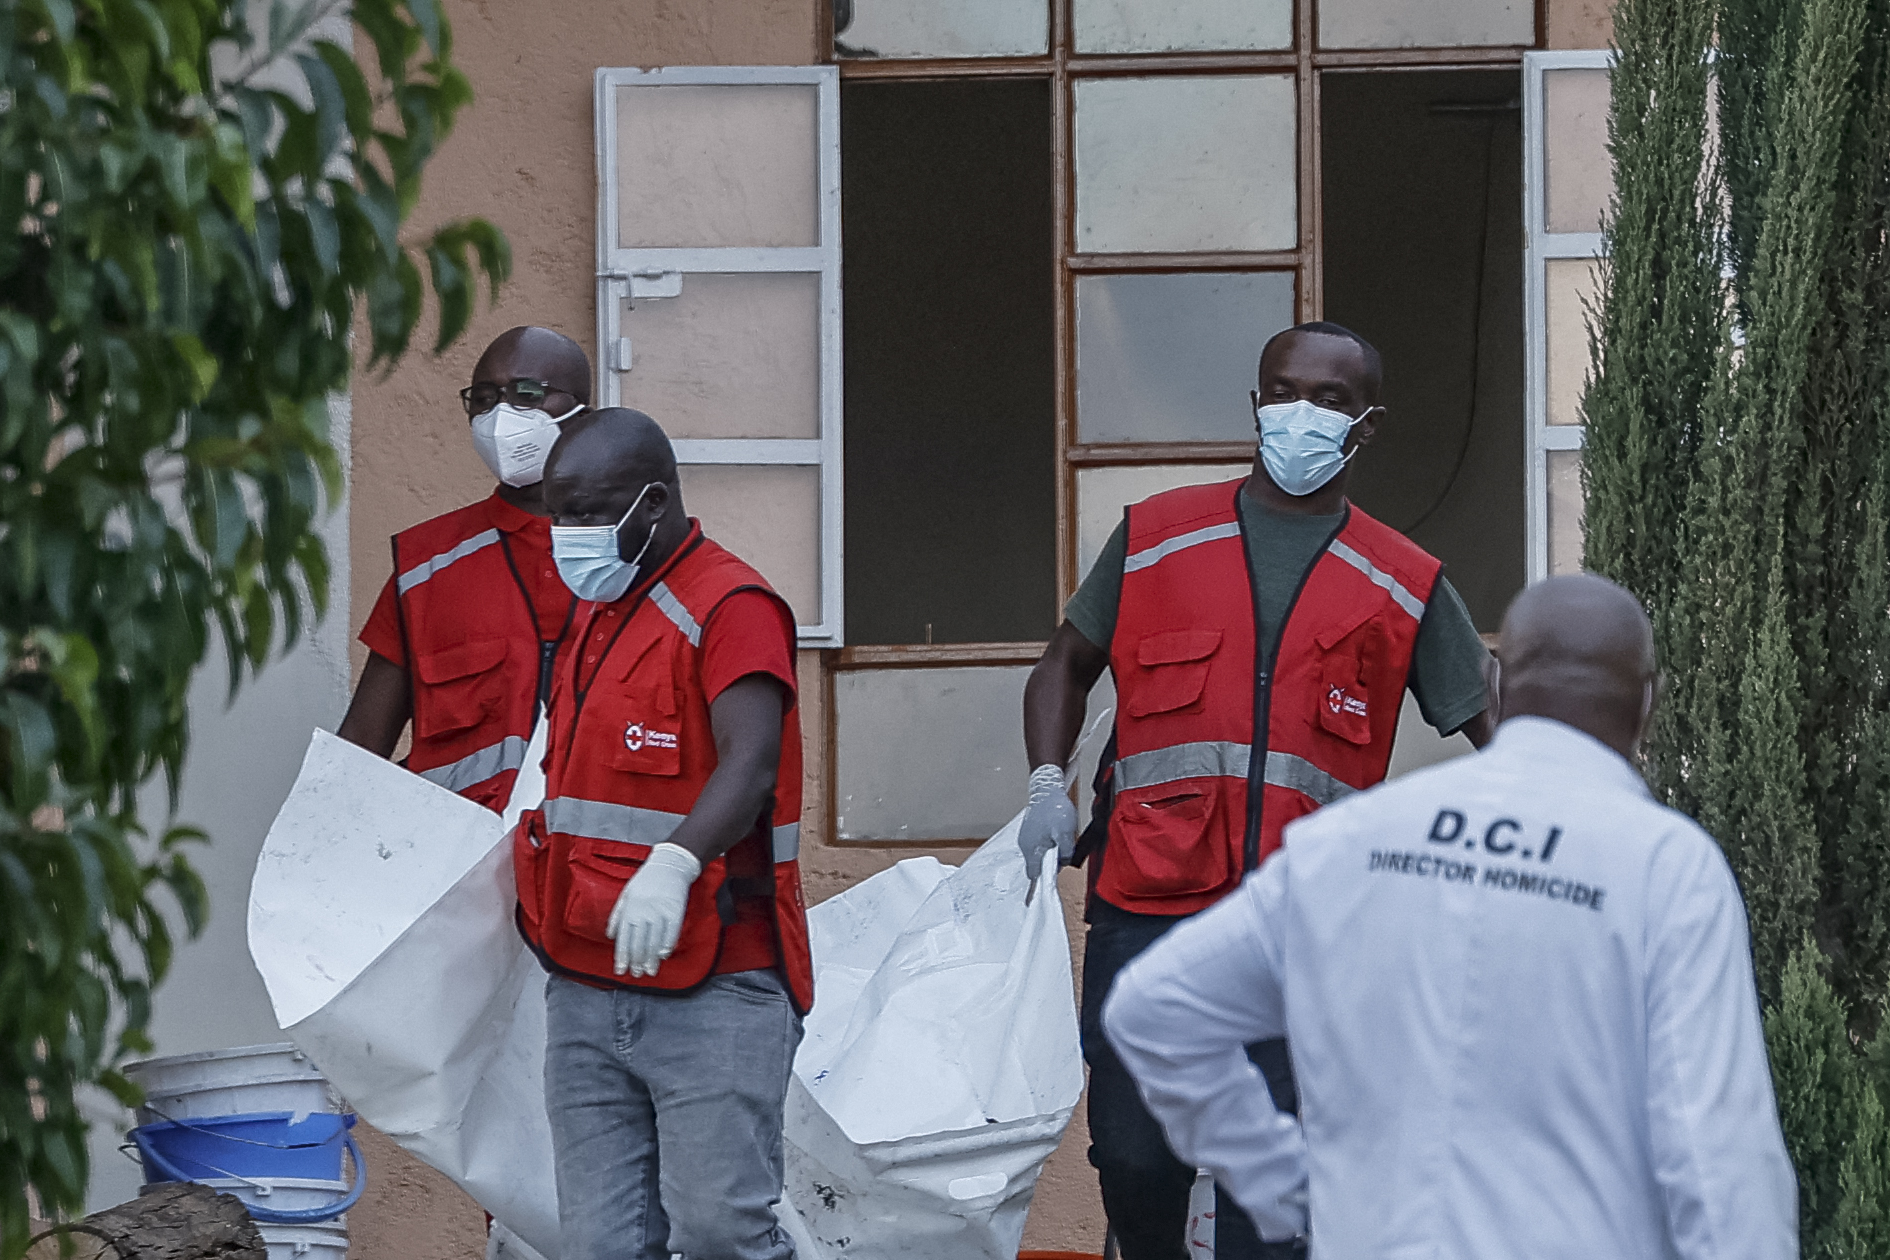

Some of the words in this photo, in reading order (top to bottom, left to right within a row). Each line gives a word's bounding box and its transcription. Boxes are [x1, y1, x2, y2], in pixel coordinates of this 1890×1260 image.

[1427, 808, 1563, 863] D.C.I
[1369, 850, 1477, 885] DIRECTOR
[1483, 866, 1607, 911] HOMICIDE
